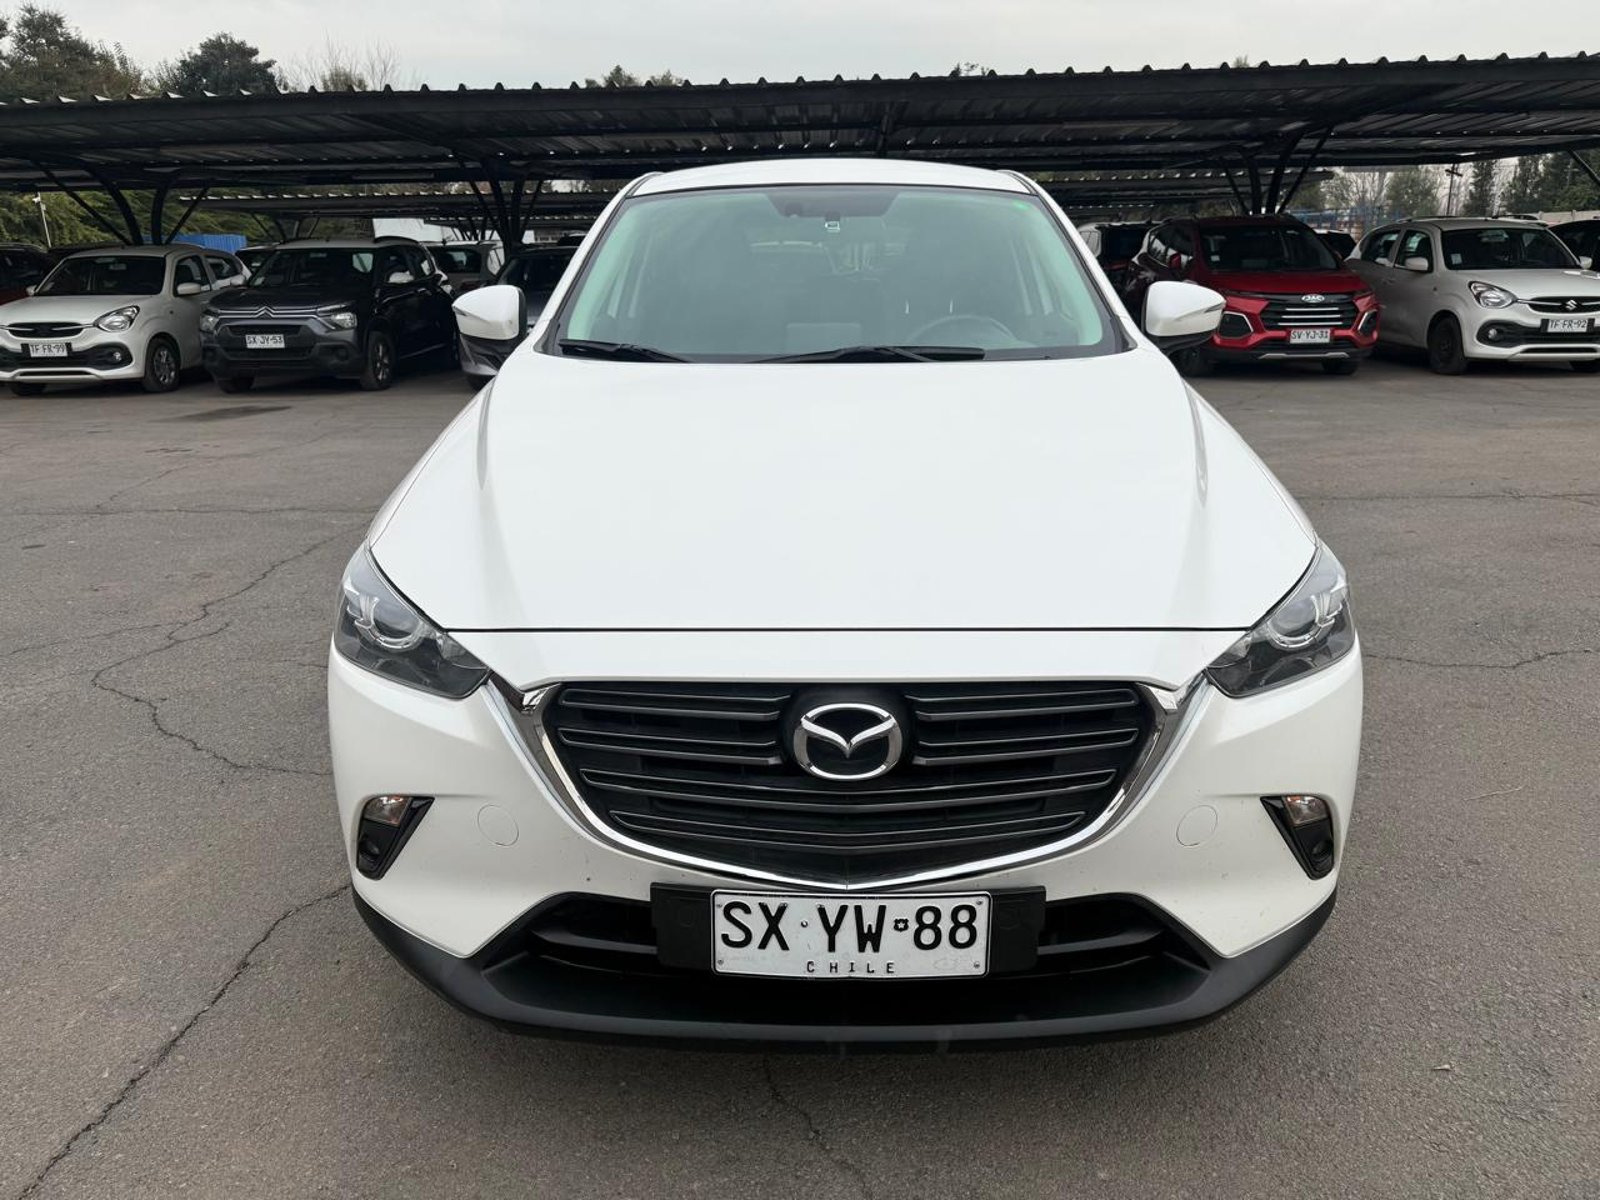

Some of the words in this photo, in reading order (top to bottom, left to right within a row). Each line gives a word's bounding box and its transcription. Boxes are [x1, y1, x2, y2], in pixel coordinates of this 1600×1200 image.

[720, 900, 790, 951] SX
[816, 904, 887, 953] YW
[913, 904, 977, 951] 88
[806, 960, 896, 974] CHILE
